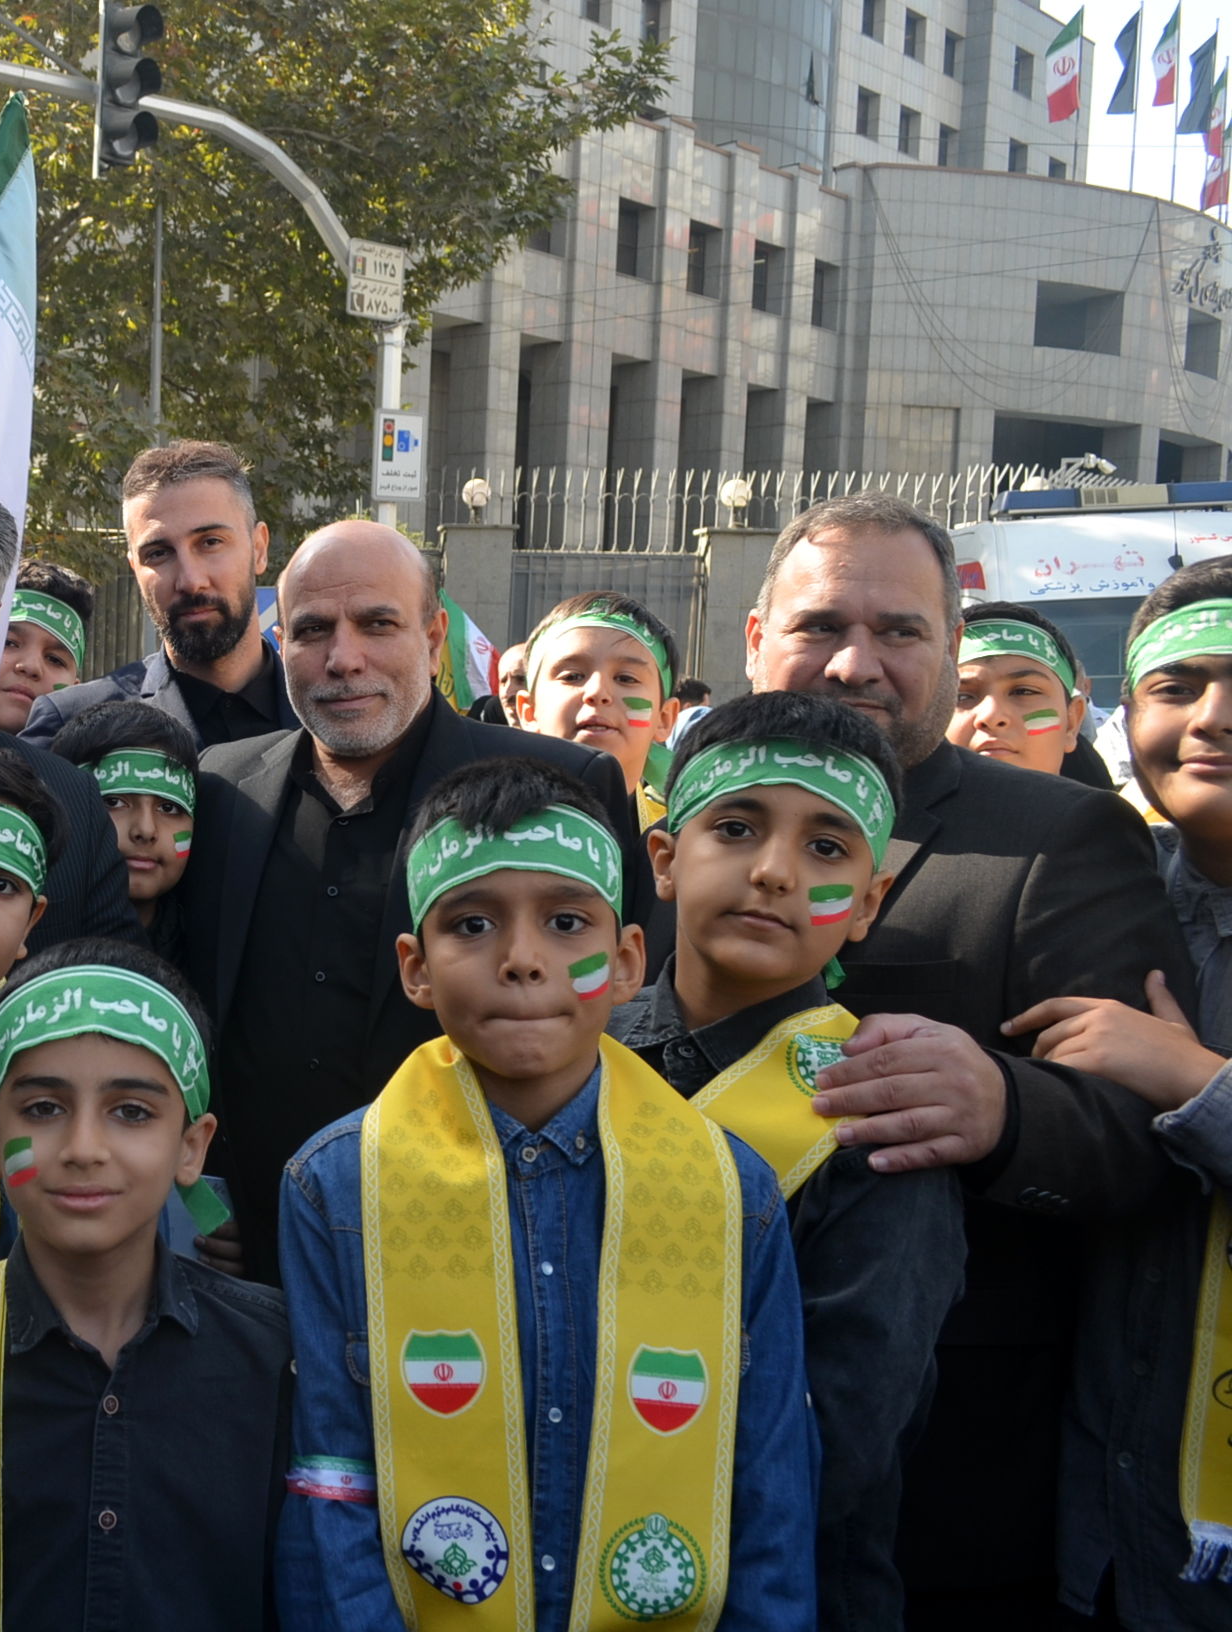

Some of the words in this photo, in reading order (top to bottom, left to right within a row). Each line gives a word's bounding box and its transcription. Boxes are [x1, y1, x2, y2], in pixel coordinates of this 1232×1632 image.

[374, 260, 396, 278] ۱۱۲۵
[1034, 550, 1145, 577] تهران
[1030, 580, 1083, 596] پزشکی
[64, 614, 72, 632] یا
[1028, 633, 1040, 650] یا
[93, 760, 130, 783] الزما
[134, 766, 181, 785] صاحب
[699, 745, 767, 791] الزمان
[774, 752, 853, 784] صاحب
[856, 776, 868, 806] یا
[503, 822, 583, 851] صاحب
[586, 836, 601, 869] یا
[10, 987, 83, 1040] الزمان
[90, 997, 168, 1032] صاحب
[172, 1022, 182, 1057] یا
